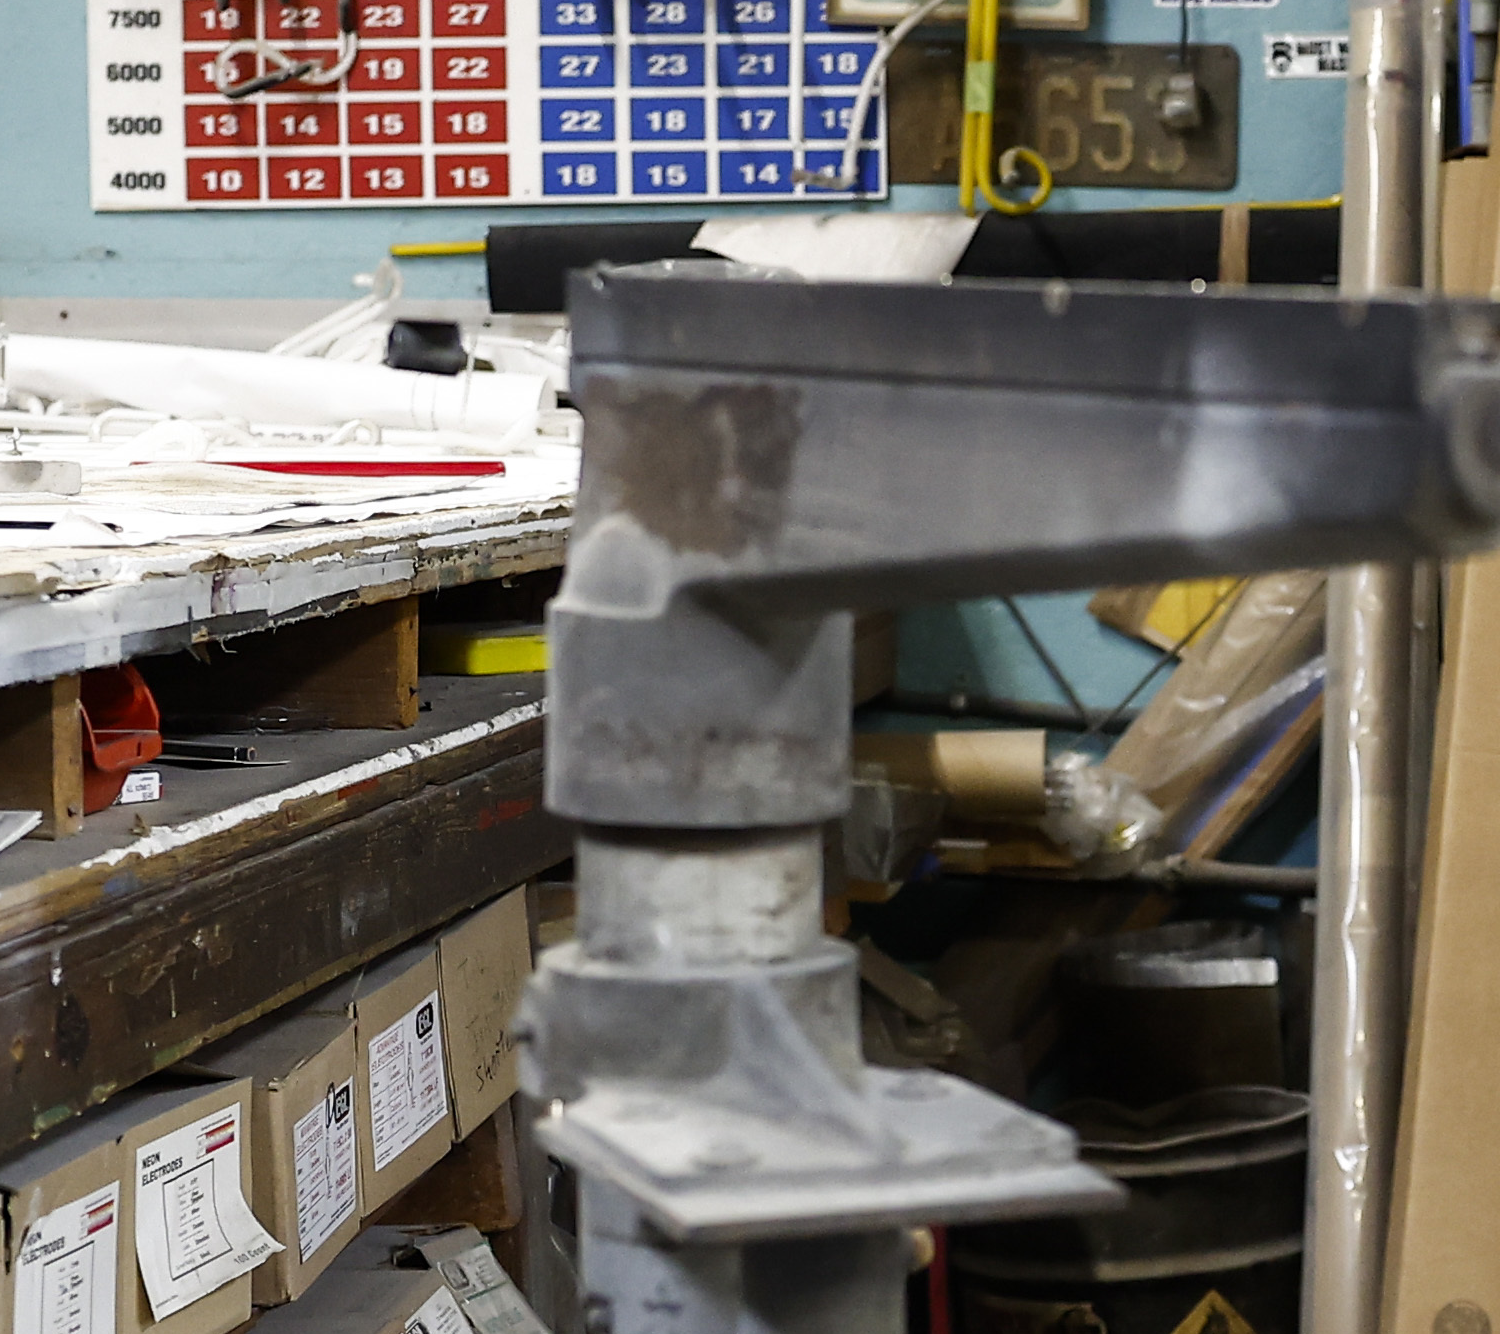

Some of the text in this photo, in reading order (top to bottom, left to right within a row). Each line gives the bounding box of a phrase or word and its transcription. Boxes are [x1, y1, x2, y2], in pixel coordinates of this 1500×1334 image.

[108, 3, 490, 31] 7500 19 22 23 27
[555, 1, 776, 26] 33 28 26
[106, 63, 162, 82] 6000
[364, 58, 404, 81] 19
[447, 56, 490, 79] 22
[558, 52, 859, 78] 27 23 21 18
[107, 111, 489, 137] 5000 13 14 15 18
[558, 110, 603, 134] 22
[646, 109, 688, 133] 18
[736, 108, 777, 132] 17
[109, 166, 491, 193] 4000 10 12 13 15
[555, 162, 781, 188] 18 15 14
[141, 1150, 162, 1170] NEON
[141, 1156, 184, 1188] ELECTRODES
